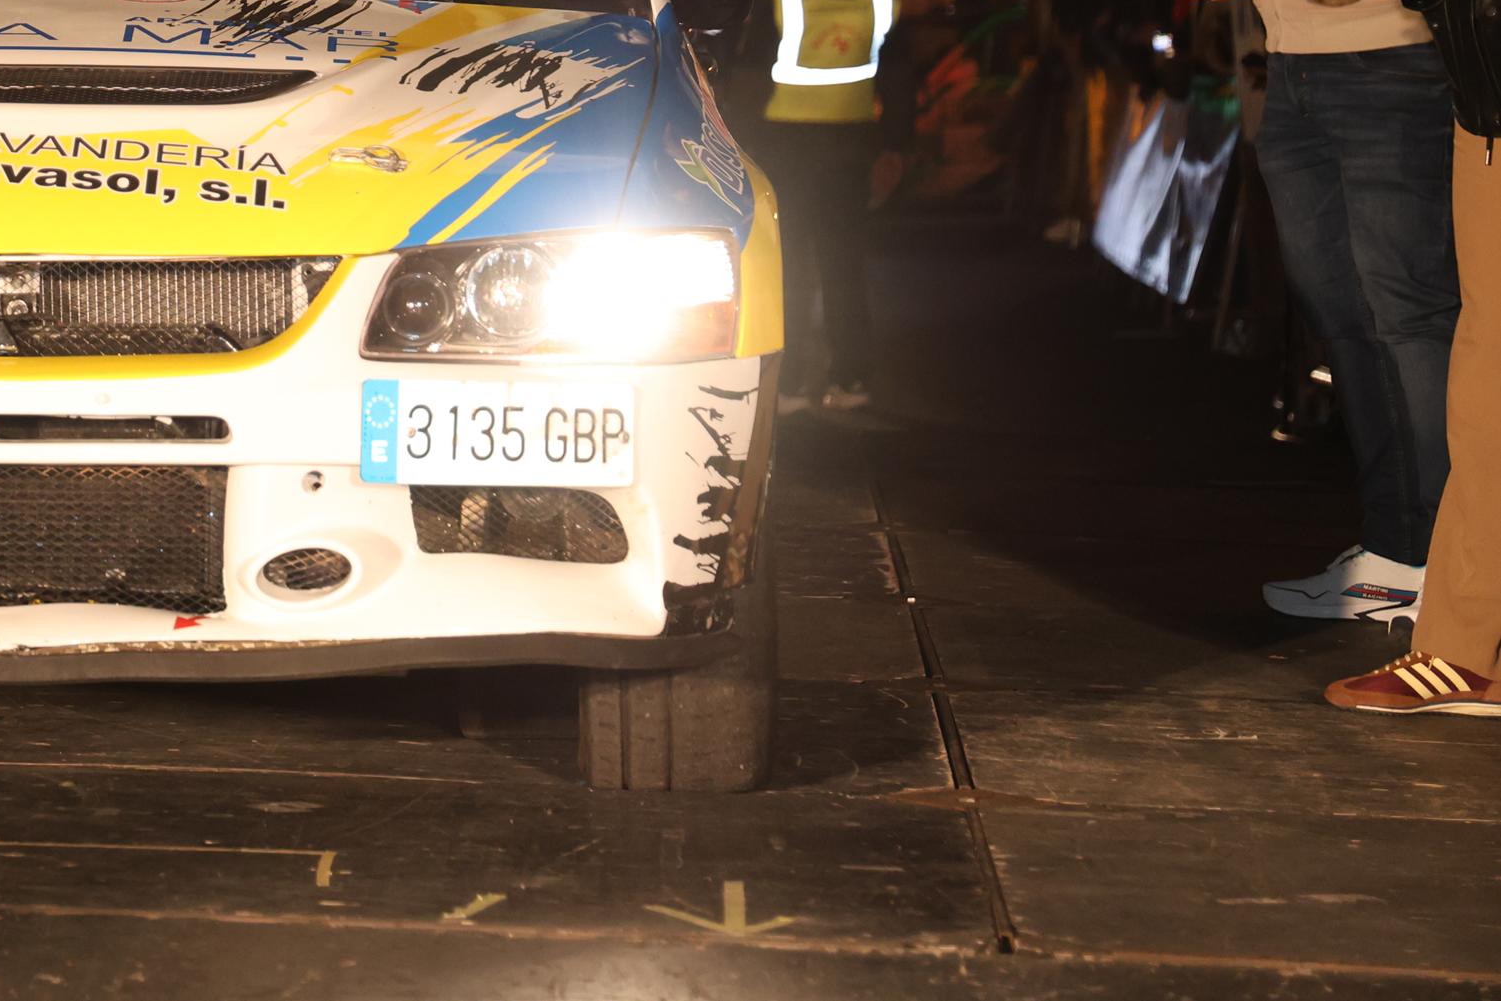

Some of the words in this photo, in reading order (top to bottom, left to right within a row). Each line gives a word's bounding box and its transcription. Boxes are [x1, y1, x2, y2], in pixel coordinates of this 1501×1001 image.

[122, 24, 400, 53] MAR
[199, 178, 286, 210] s.l.
[406, 404, 526, 461] 3135
[544, 407, 626, 463] GBP
[371, 439, 389, 463] E
